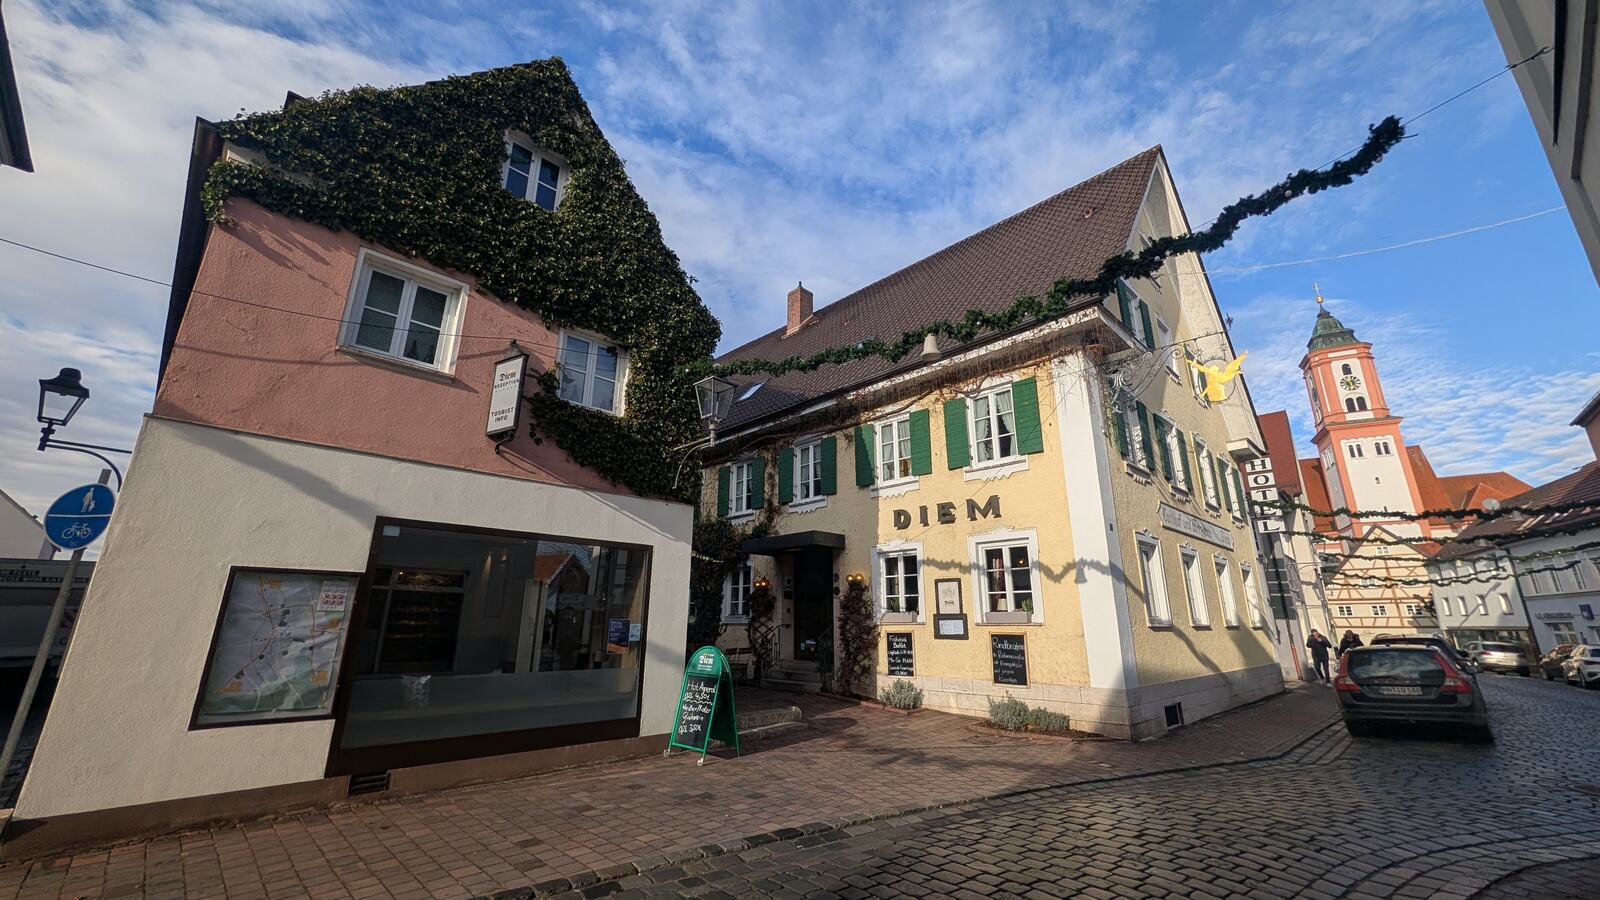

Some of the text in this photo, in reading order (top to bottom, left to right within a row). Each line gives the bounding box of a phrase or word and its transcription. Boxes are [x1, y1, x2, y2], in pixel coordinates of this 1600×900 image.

[491, 406, 515, 417] TOURIST
[495, 414, 508, 423] INFO
[893, 495, 1002, 530] DIEM
[687, 681, 717, 694] Hot Aperol
